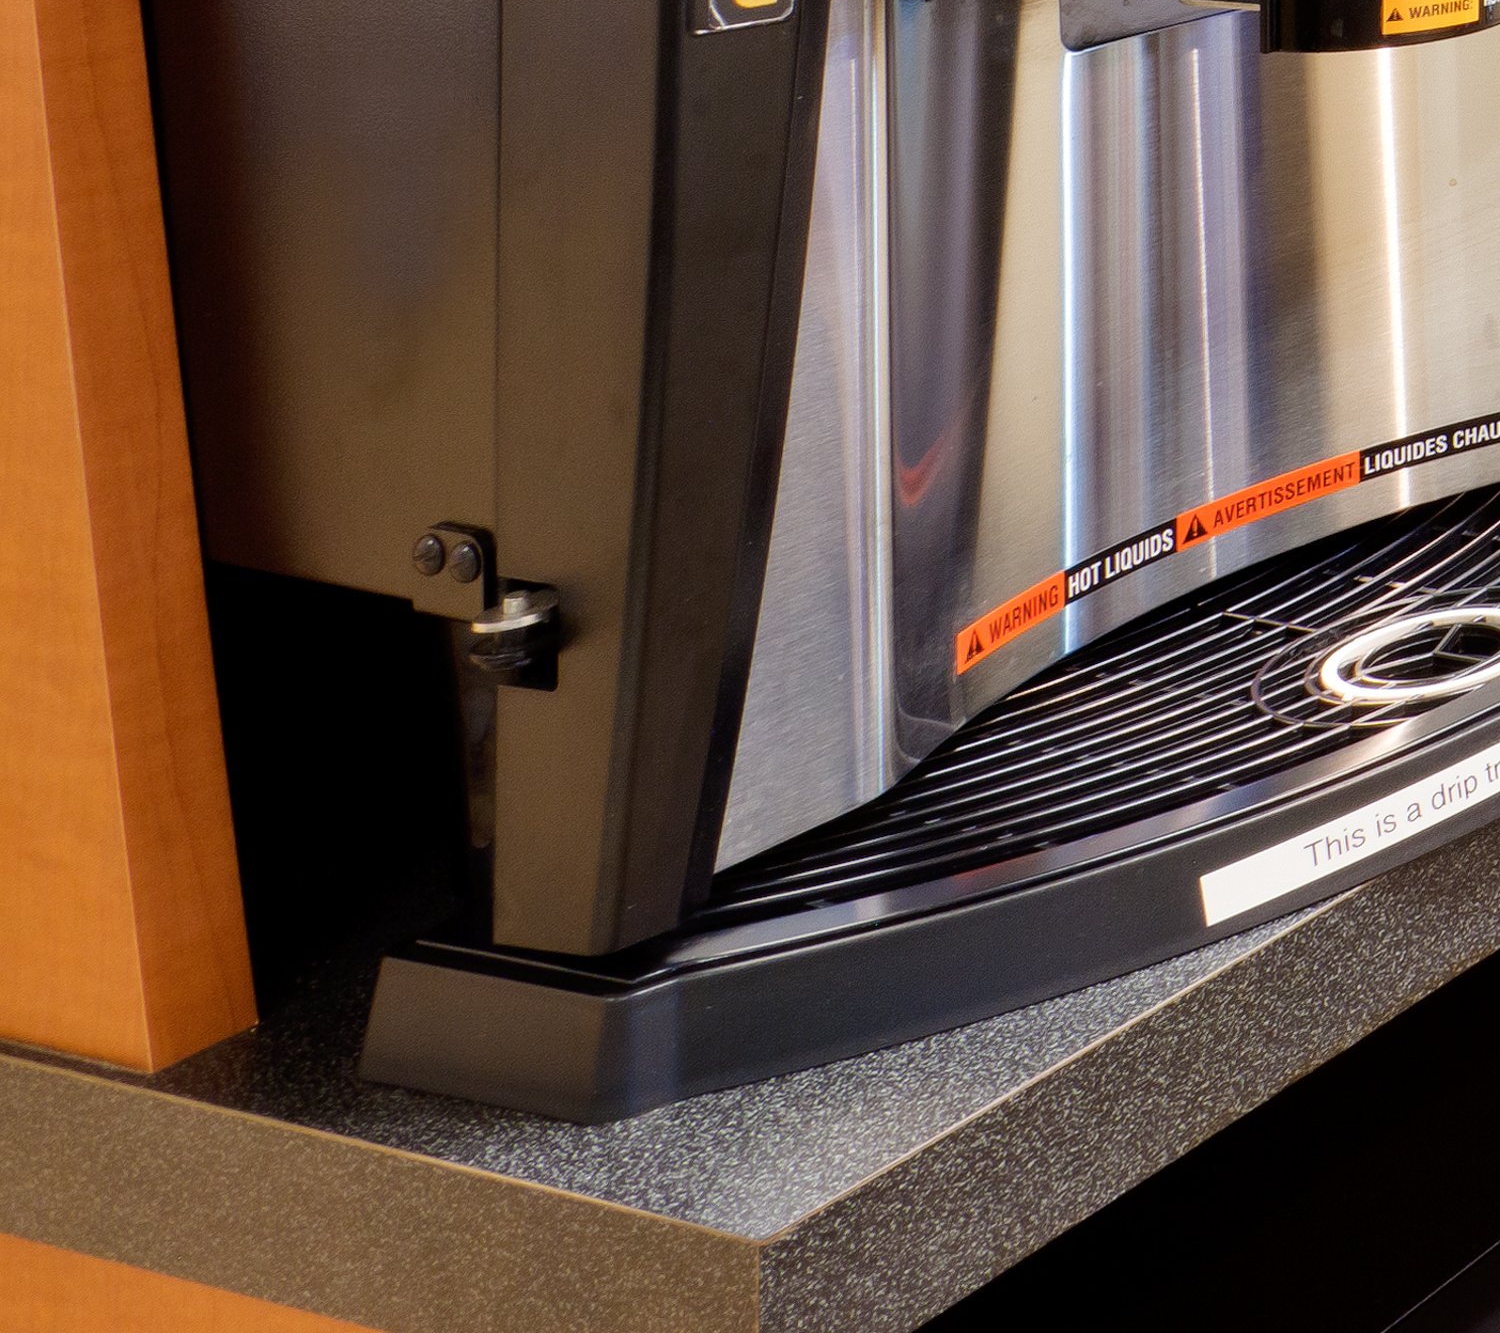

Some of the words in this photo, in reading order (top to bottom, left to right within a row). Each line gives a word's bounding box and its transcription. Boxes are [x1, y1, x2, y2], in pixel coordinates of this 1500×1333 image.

[988, 584, 1061, 645] WARNING
[1067, 561, 1103, 600] HOT
[1105, 529, 1175, 582] LIQUIDS
[1212, 460, 1356, 531] AVERTISSEMENT
[1363, 433, 1449, 476] LIQUIDES
[1304, 825, 1366, 868] This
[1375, 812, 1397, 839] is
[1407, 802, 1422, 823] a
[1431, 770, 1478, 813] drip
